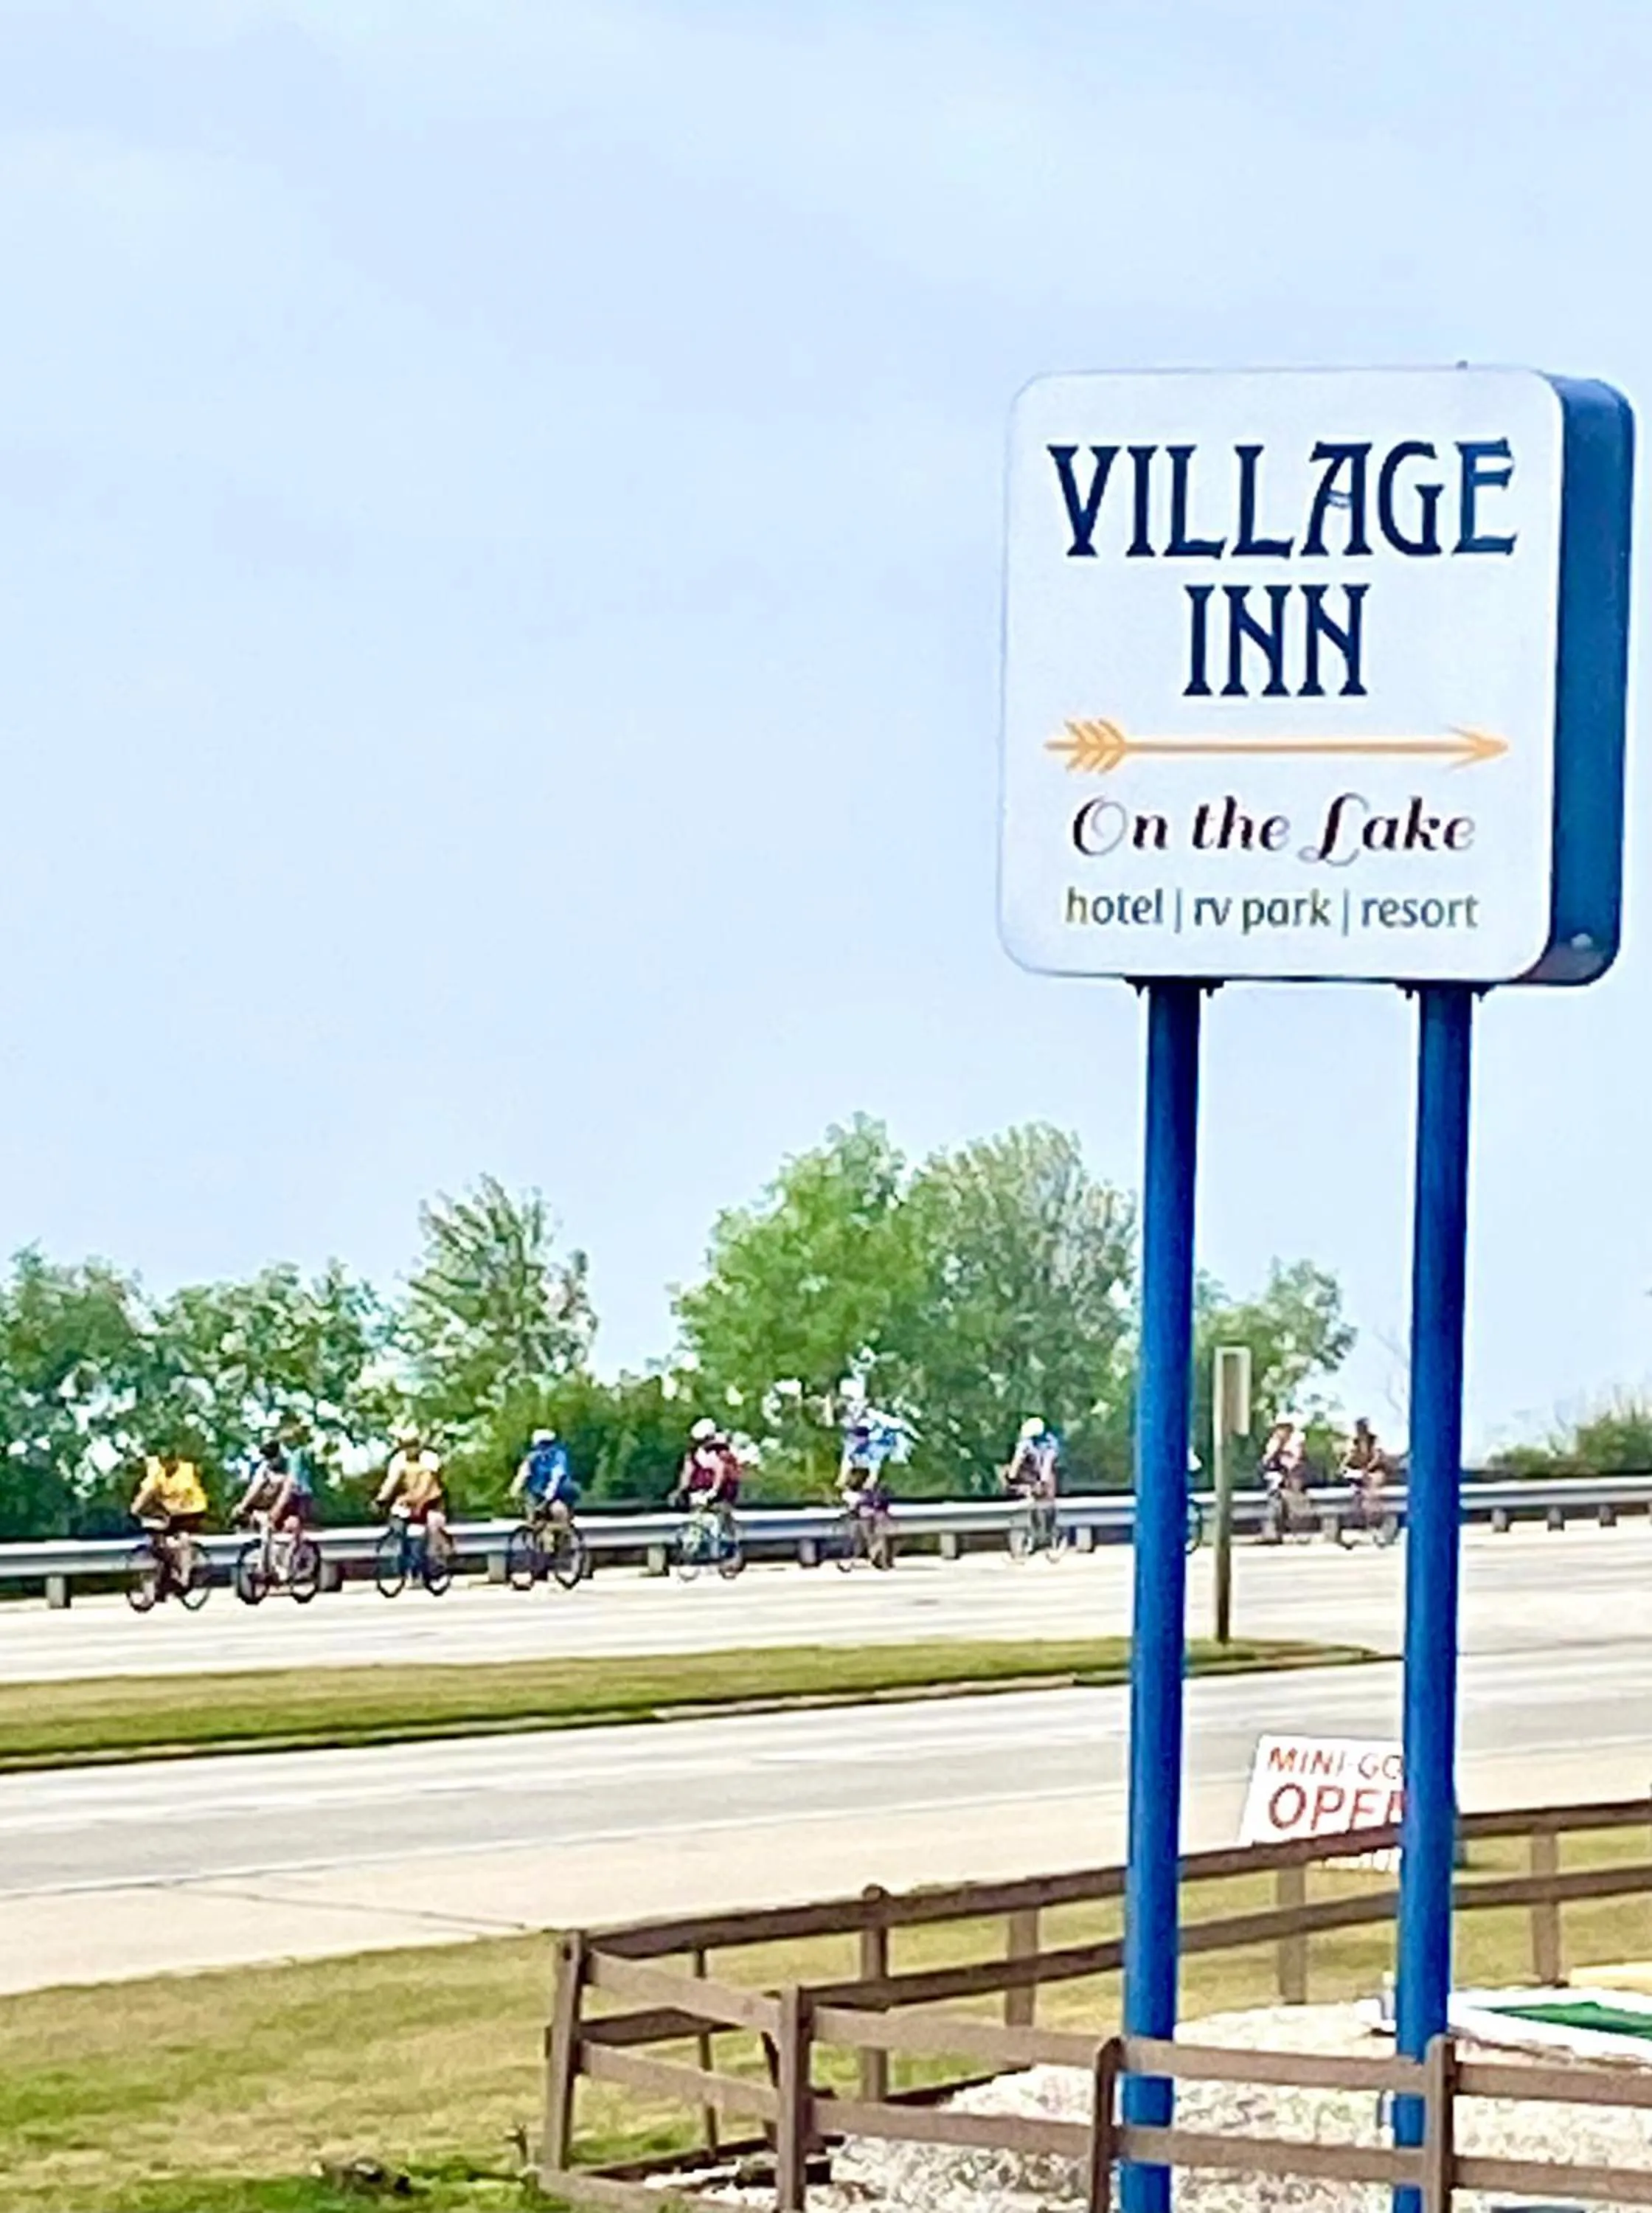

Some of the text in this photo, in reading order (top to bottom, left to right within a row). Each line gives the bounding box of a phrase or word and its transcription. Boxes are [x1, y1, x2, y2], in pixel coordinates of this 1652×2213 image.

[1047, 437, 1517, 559] VILLAGE
[1183, 583, 1371, 697] INN
[1072, 792, 1476, 867] On the Lake
[1066, 885, 1479, 935] hotel rv park resort
[1267, 1746, 1404, 1781] MINI-GO
